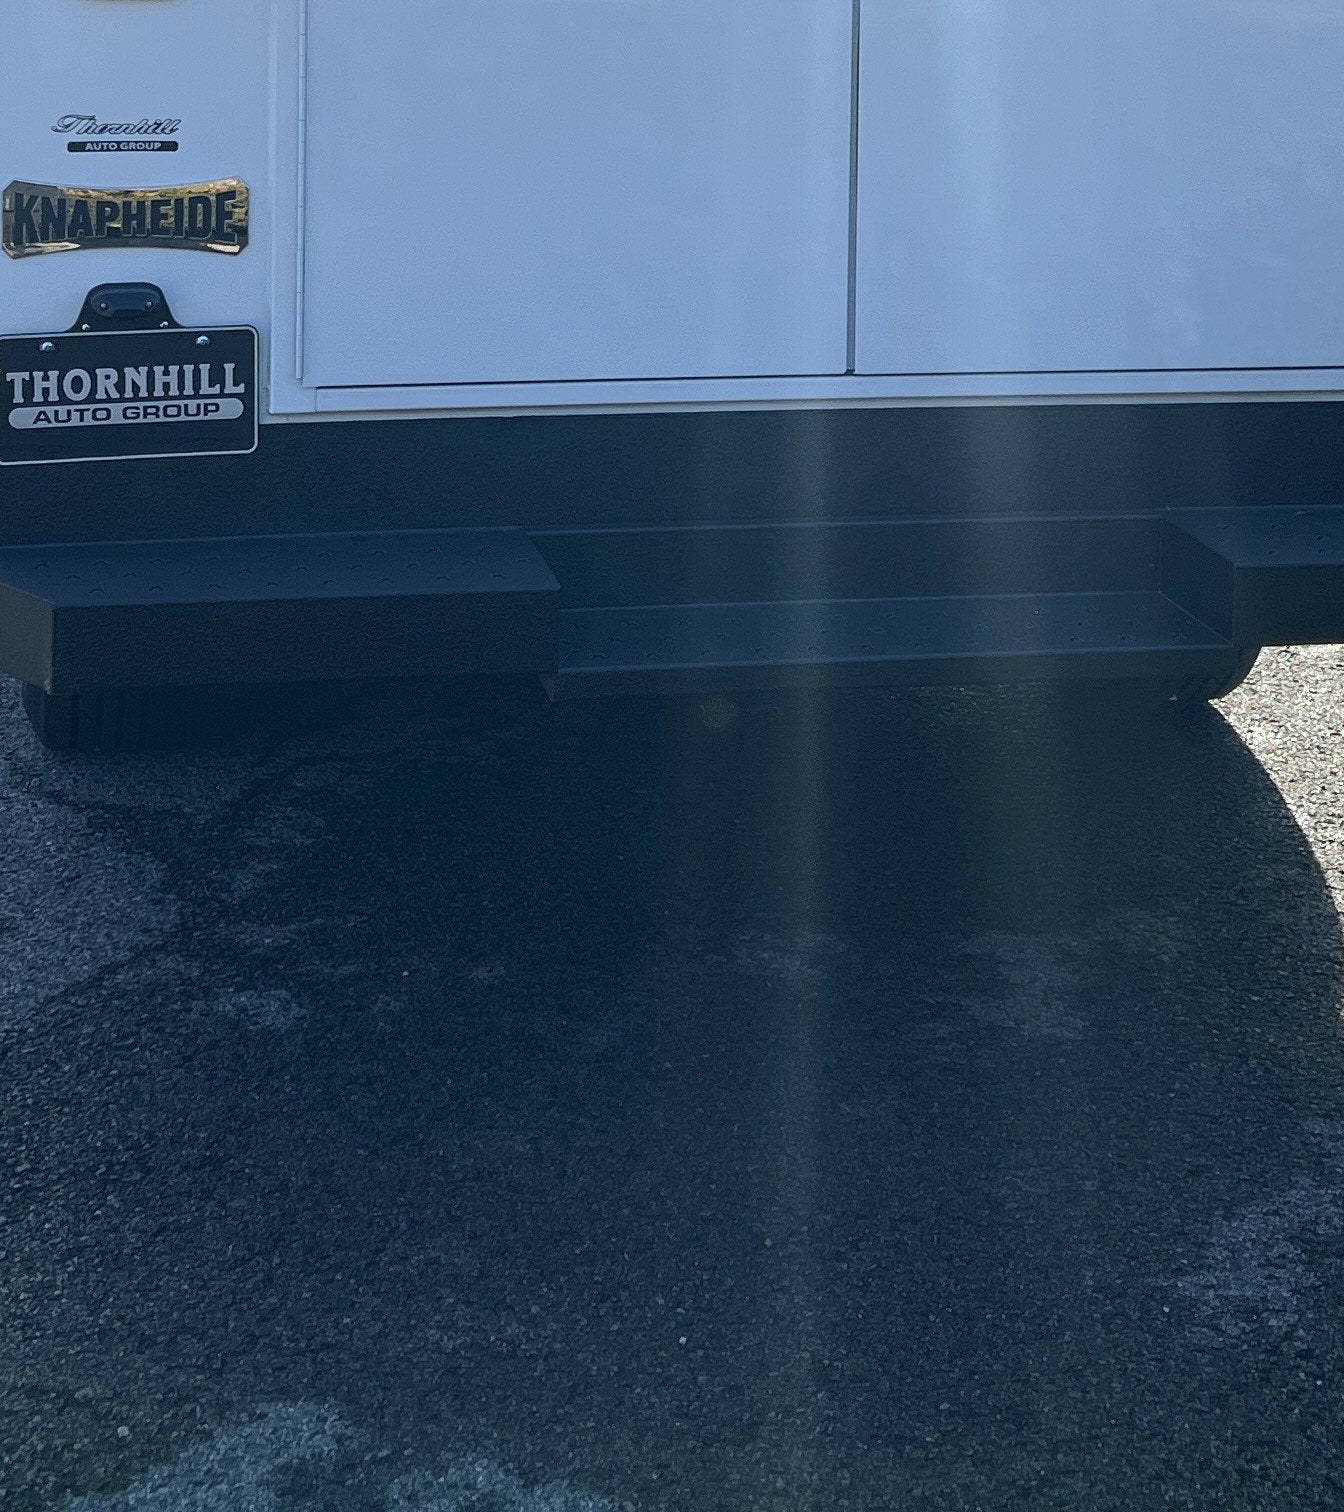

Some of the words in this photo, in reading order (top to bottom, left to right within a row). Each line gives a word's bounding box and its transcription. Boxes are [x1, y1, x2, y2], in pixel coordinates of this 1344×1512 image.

[50, 114, 182, 135] Thornhill
[84, 142, 118, 151] AUTO
[119, 142, 162, 150] GROUP
[11, 190, 238, 245] KNAPHEIDE
[5, 362, 246, 404] THORNHILL
[32, 406, 112, 425] AUTO
[121, 402, 220, 420] GROUP
